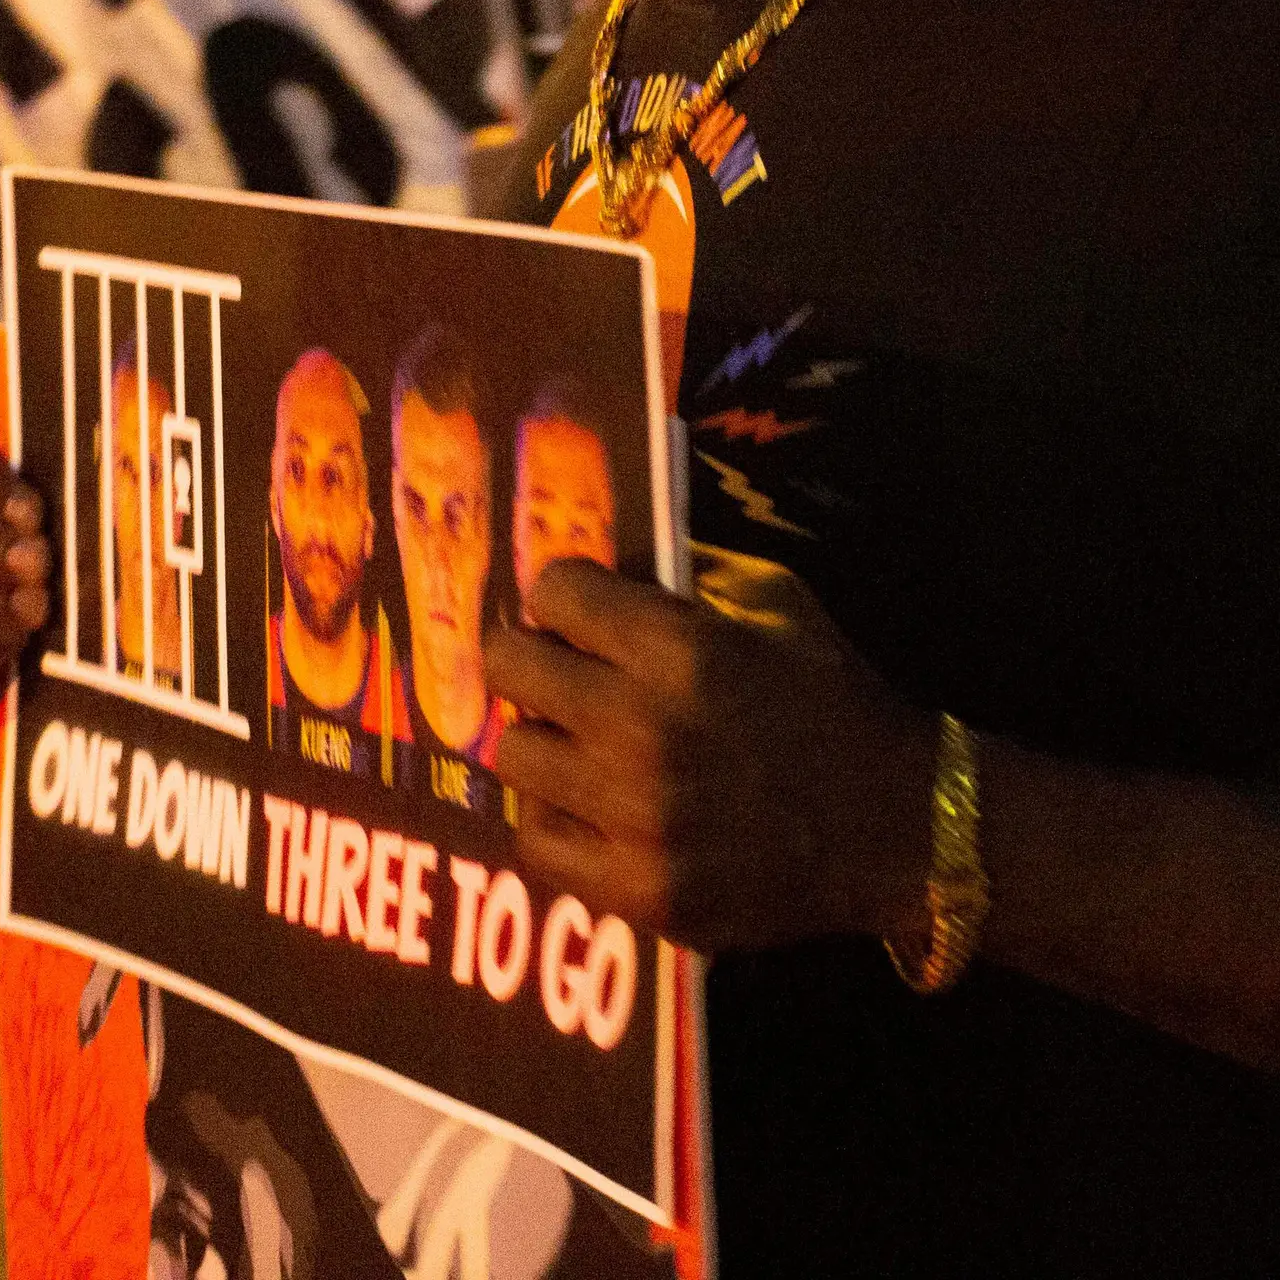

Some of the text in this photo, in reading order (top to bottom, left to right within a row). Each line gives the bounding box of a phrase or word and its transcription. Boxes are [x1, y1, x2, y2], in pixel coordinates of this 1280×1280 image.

[28, 719, 638, 1051] ONE DOWN THREE TO GO
